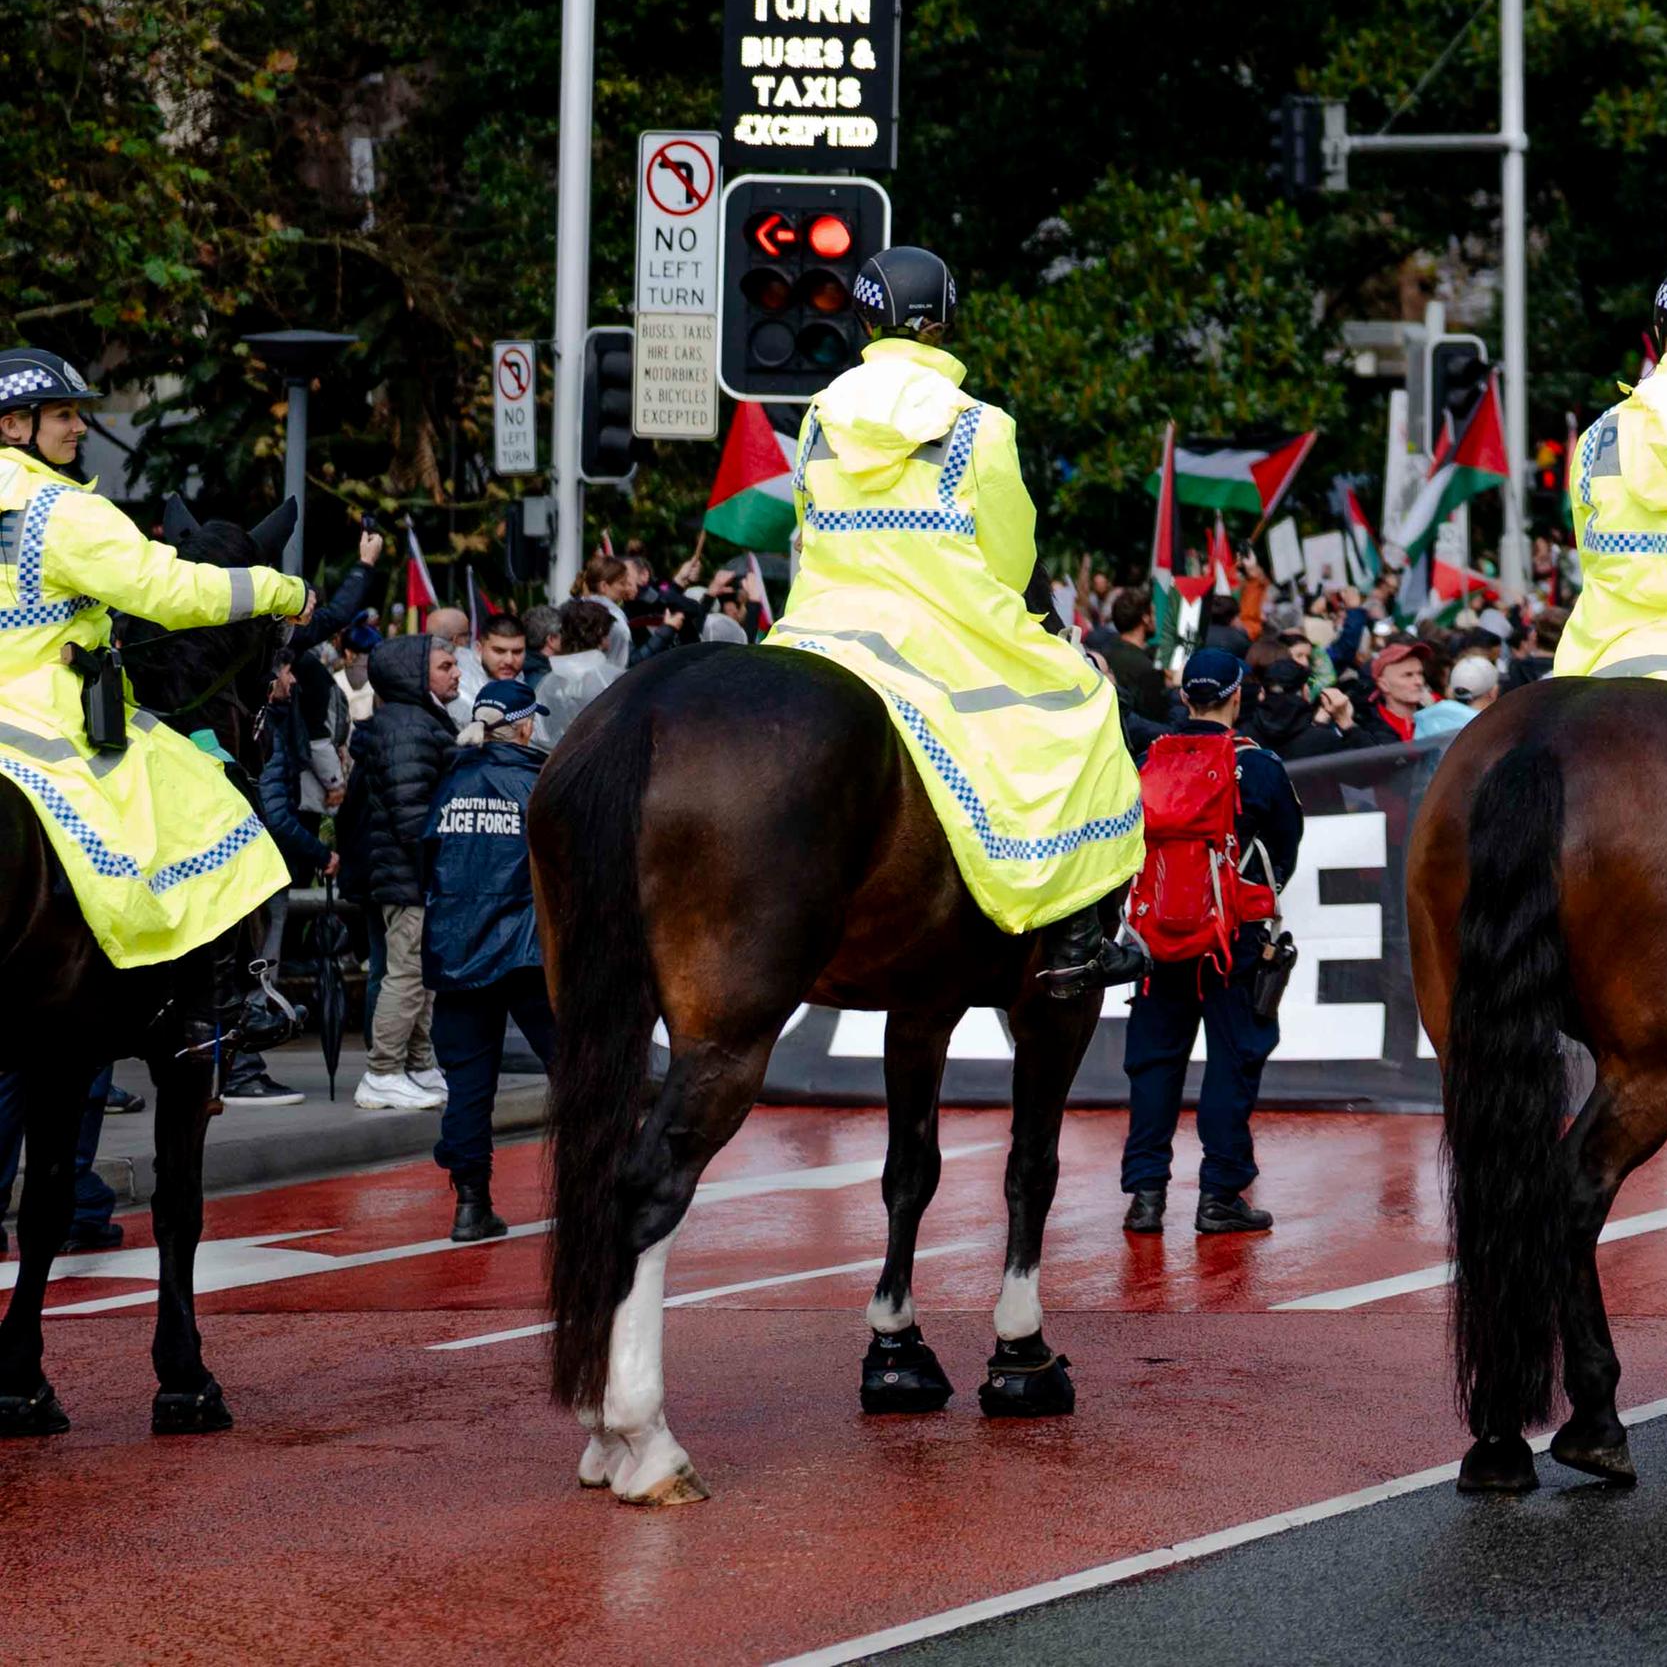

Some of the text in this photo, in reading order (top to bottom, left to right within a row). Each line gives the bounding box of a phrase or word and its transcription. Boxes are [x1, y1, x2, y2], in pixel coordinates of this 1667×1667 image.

[741, 36, 876, 70] BUSES &
[752, 75, 862, 108] TAXIS
[734, 114, 878, 148] EXCEPTED
[655, 227, 697, 252] NO
[649, 260, 702, 279] LEFT
[647, 287, 705, 306] TURN
[682, 324, 713, 340] TAXIS
[647, 345, 669, 360] HIRE
[644, 367, 708, 383] MOTORBIKES
[643, 389, 707, 405] & BICYCLES
[504, 407, 525, 426] NO
[643, 409, 707, 426] EXCEPTED
[502, 432, 528, 447] LEFT
[502, 451, 531, 463] TURN
[450, 797, 487, 811] SOUTH
[487, 797, 519, 814] WALES
[476, 812, 520, 834] FORCE
